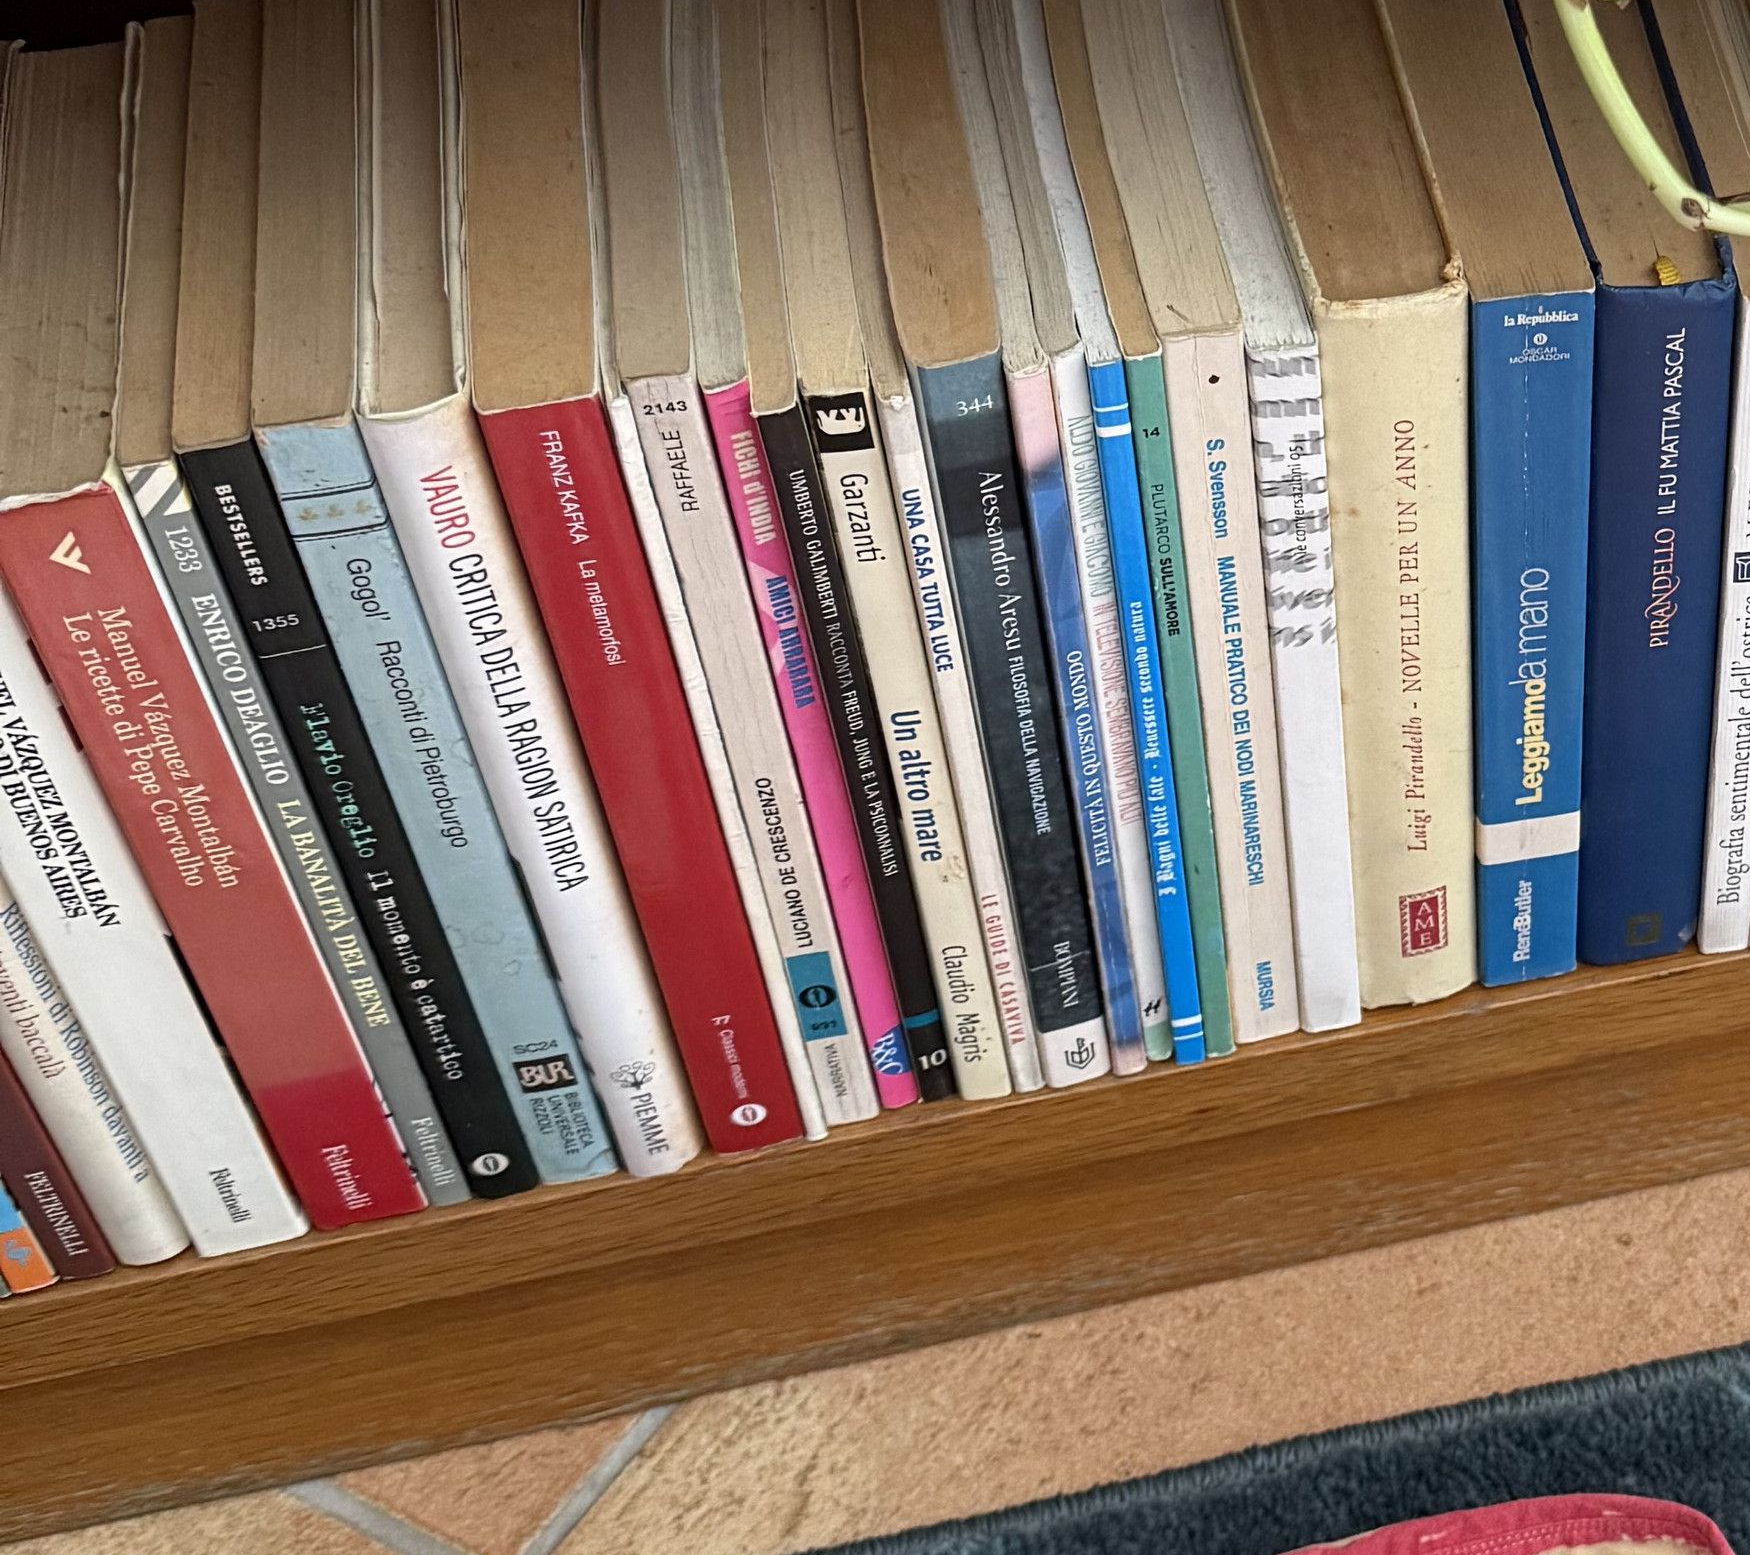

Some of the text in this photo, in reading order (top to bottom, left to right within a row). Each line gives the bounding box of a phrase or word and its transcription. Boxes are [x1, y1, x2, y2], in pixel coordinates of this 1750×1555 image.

[1517, 309, 1579, 326] Repubblica
[643, 401, 688, 416] 2143
[662, 430, 700, 513] RAFFAELE
[956, 395, 994, 417] 344
[1141, 426, 1160, 439] 14
[214, 484, 268, 586] BESTSELLERS
[538, 430, 627, 667] FRANZ KAFKA metamorfosi
[1149, 483, 1181, 637] PLUTARCO SULL'AMORE
[1645, 327, 1686, 649] PIRANDELLO FU MATTIA PASCAL
[252, 613, 300, 633] 1355
[901, 488, 954, 673] UNA CASA TUTTA LUCE
[978, 471, 1052, 836] Alessandro Aresu DELLA NAVIGAZIONE
[1394, 419, 1431, 853] Luigi Pirandello NOVELLE PER UN ANNO
[1519, 568, 1550, 655] mano
[63, 612, 203, 887] Le ricette Pepe Carvalho
[97, 606, 239, 889] Manuel Vázquez Montalbán
[376, 641, 420, 724] Racconti
[415, 746, 468, 849] Pietroburgo
[420, 465, 590, 892] VAURO CRITICA DELLA RAGION SATIRICA
[788, 468, 899, 878] UMBERTO GALIMBERTI RACCONTA PSICOANALISI
[1066, 650, 1101, 778] QUESTO MONDO
[1208, 460, 1265, 886] Svensson MANUALE PRATICO NODI MARINARESCHI
[6, 717, 121, 928] VÁZQUEZ MONTALBÁN
[164, 526, 391, 1028] 1233 ENRICO DEAGLIO BANALITÀ DEL BENE
[299, 702, 421, 975] Flavio Oreglio momento
[839, 473, 983, 1064] Garzanti Un altro mare Claudio Magris
[2, 776, 87, 918] BUENOS AIRES
[755, 777, 813, 948] LUCIANO DE CRESCENZO
[1717, 840, 1750, 906] Biografia
[918, 1048, 948, 1070] 10
[999, 981, 1026, 1045] CASAVIVA
[1255, 960, 1276, 1013] MURSIA
[517, 1060, 574, 1089] BUR
[629, 1093, 671, 1156] PIEMME
